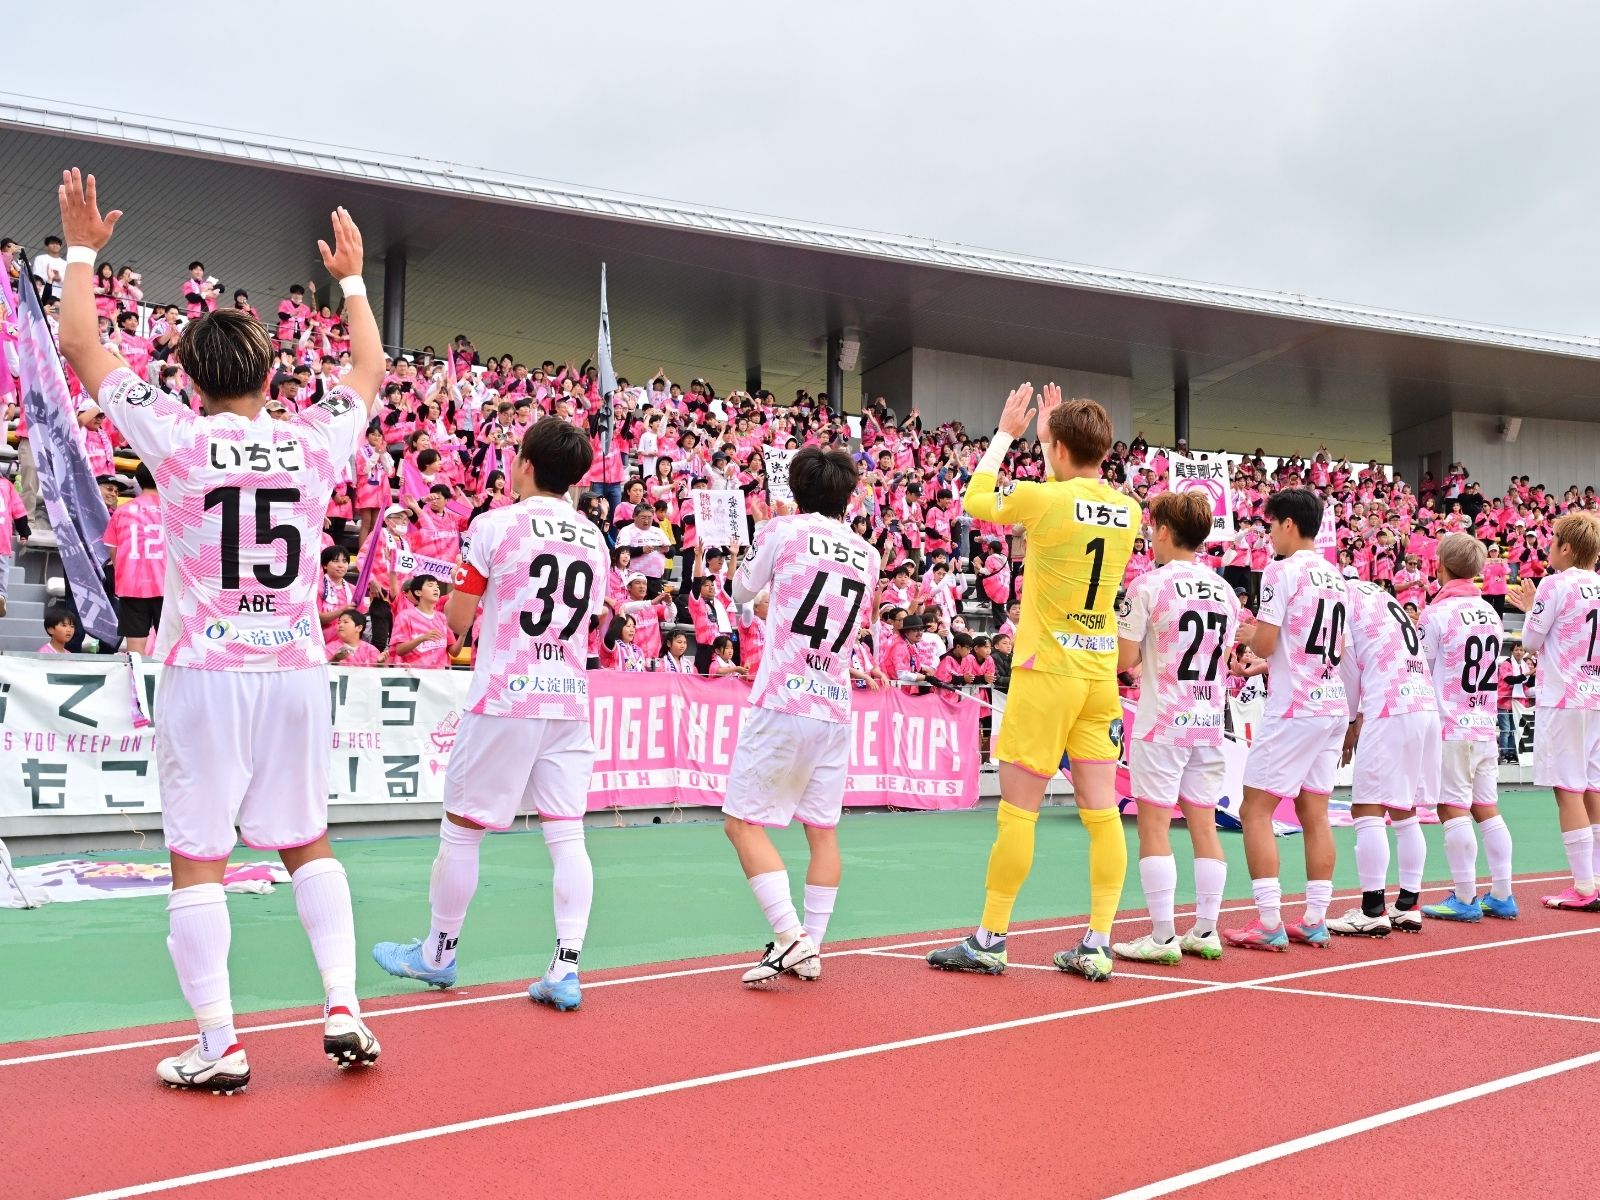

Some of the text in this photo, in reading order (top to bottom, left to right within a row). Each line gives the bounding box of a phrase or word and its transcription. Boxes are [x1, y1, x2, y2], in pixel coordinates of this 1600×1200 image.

[211, 441, 299, 472] いちご
[1176, 462, 1223, 479] 質実剛犬
[1075, 502, 1128, 528] いちご
[129, 523, 163, 560] 12
[204, 486, 301, 589] 15
[532, 518, 597, 550] いちご
[401, 555, 414, 569] 58
[809, 536, 868, 572] いちご
[453, 567, 469, 586] C
[1084, 537, 1105, 611] 1
[238, 594, 277, 613] ABE
[520, 553, 593, 641] 39
[1175, 580, 1225, 603] いちご
[791, 570, 866, 655] 47
[1460, 608, 1498, 625] いちご
[232, 618, 310, 646] 淀開発
[1305, 598, 1345, 666] 40
[1387, 601, 1419, 656] 8
[535, 642, 566, 662] YOTA
[1071, 634, 1114, 651] 大淀開発
[1177, 610, 1228, 681] 27
[1461, 634, 1500, 694] 82
[531, 676, 586, 695] 大淀開発
[1193, 685, 1211, 701] RIKU
[594, 695, 752, 766] OGETHE
[892, 711, 960, 772] TOP!
[1192, 714, 1222, 727] 大淀開
[24, 732, 56, 752] YOU
[66, 734, 111, 752] KEEP
[120, 735, 142, 752] ON
[349, 732, 380, 749] HERE
[602, 772, 650, 789] ITH
[876, 776, 957, 795] HEARTS
